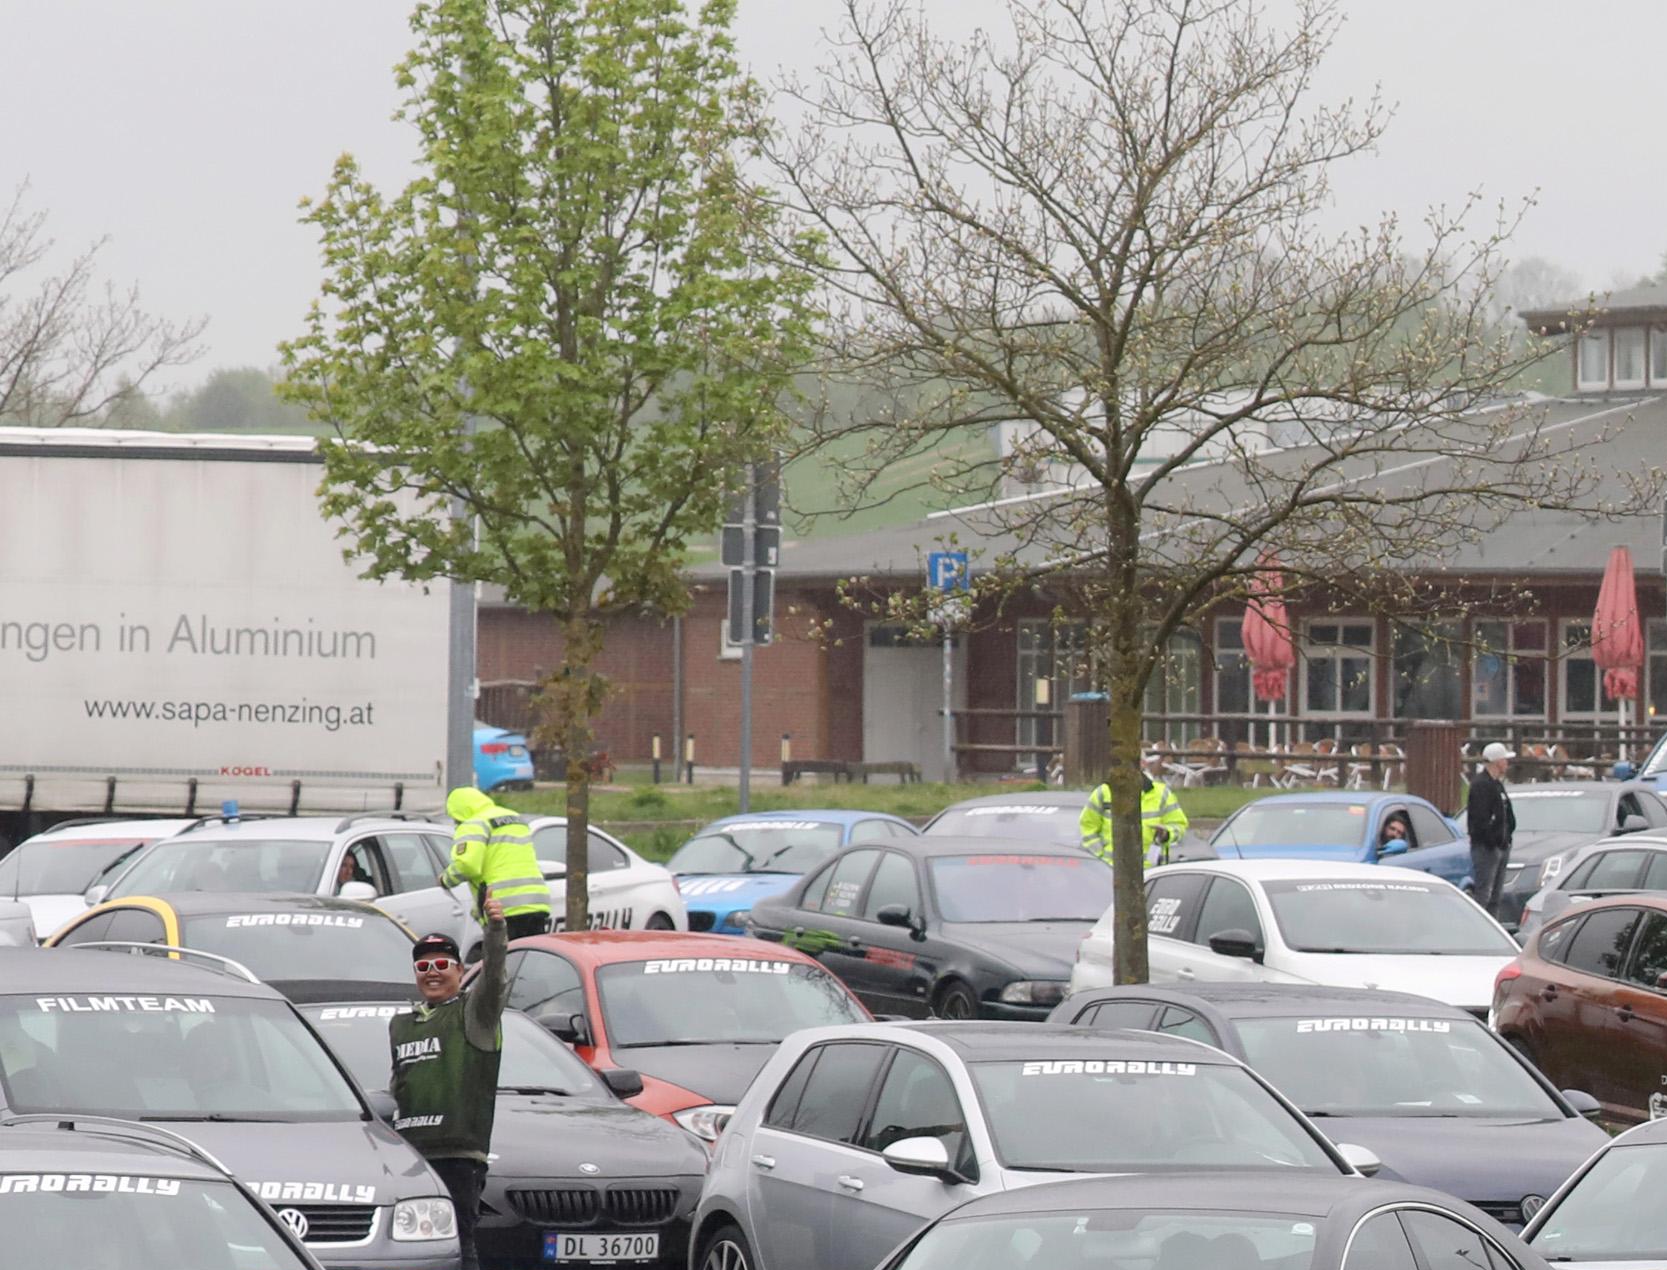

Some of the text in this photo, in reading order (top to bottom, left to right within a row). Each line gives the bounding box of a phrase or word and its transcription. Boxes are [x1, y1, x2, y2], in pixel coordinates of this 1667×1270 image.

[1, 612, 377, 663] ngen in Aluminium
[85, 697, 375, 731] www.sapa-nenzing.at
[225, 913, 364, 929] EURORALLY
[643, 958, 792, 975] EURORALLY
[35, 996, 216, 1013] FILMTEAM
[1296, 1018, 1450, 1033] EURORALLY
[1021, 1061, 1197, 1076] EURORALLY
[564, 1236, 588, 1256] DL
[598, 1236, 655, 1256] 36700
